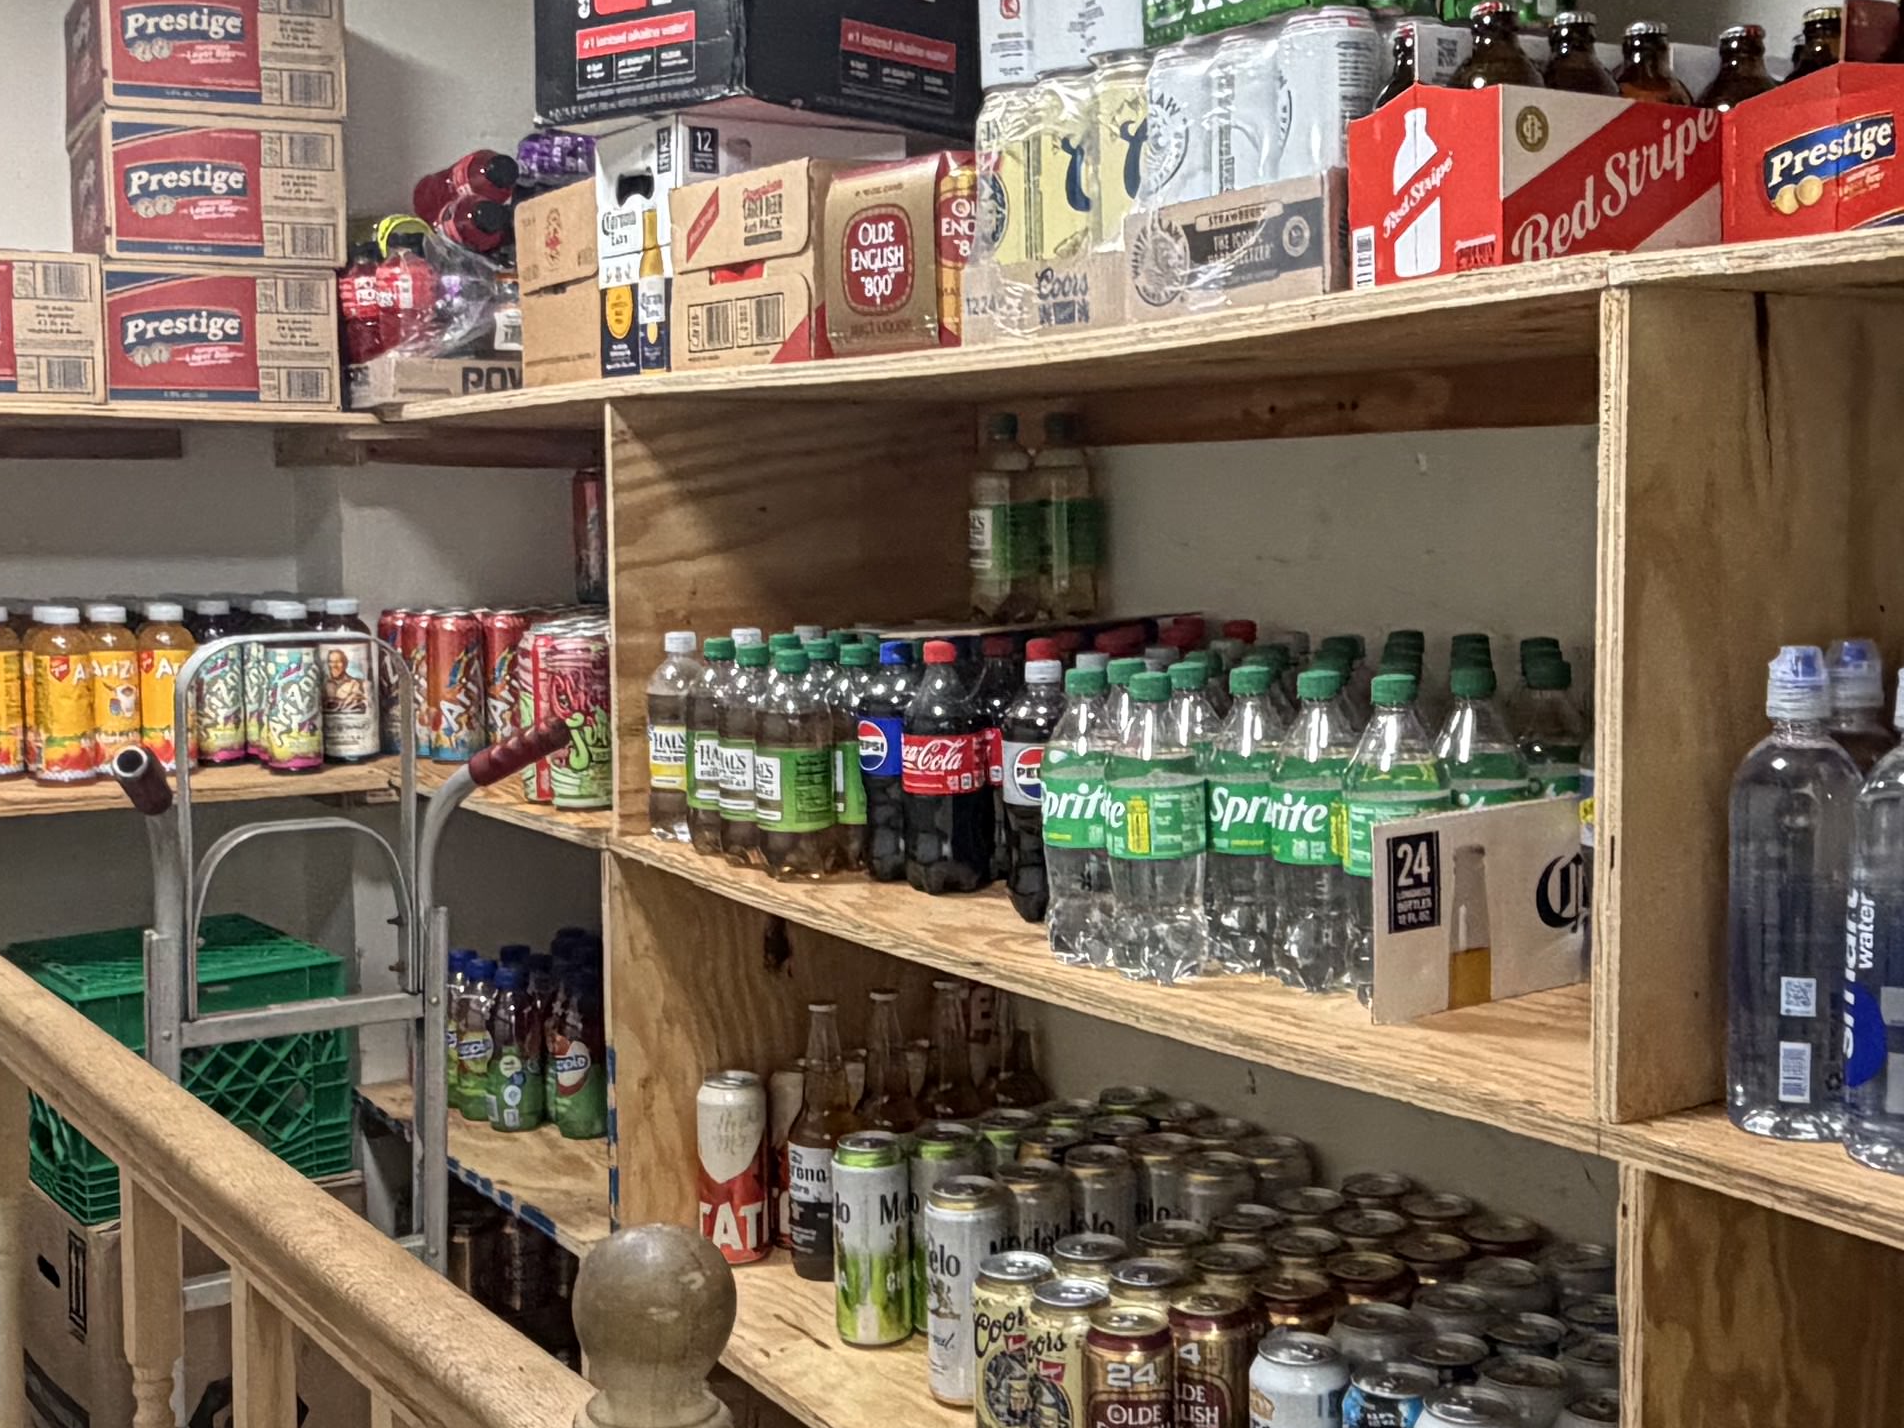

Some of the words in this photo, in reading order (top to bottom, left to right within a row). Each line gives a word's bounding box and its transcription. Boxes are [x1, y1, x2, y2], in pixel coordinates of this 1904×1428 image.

[125, 8, 243, 39] Prestige
[696, 131, 712, 152] 12
[1768, 120, 1893, 188] Prestige
[127, 165, 245, 196] Prestige
[1383, 197, 1409, 238] Red
[1410, 154, 1453, 210] Stripe
[1511, 175, 1600, 262] Red
[1601, 107, 1720, 216] Stripe
[858, 221, 895, 247] OLDE
[850, 245, 904, 273] ENGLISH
[1037, 267, 1089, 298] Coors
[124, 312, 241, 344] Prestige
[1397, 841, 1430, 887] 24
[1857, 892, 1875, 969] water
[1107, 1362, 1157, 1388] 24
[1107, 1404, 1162, 1425] OLDE
